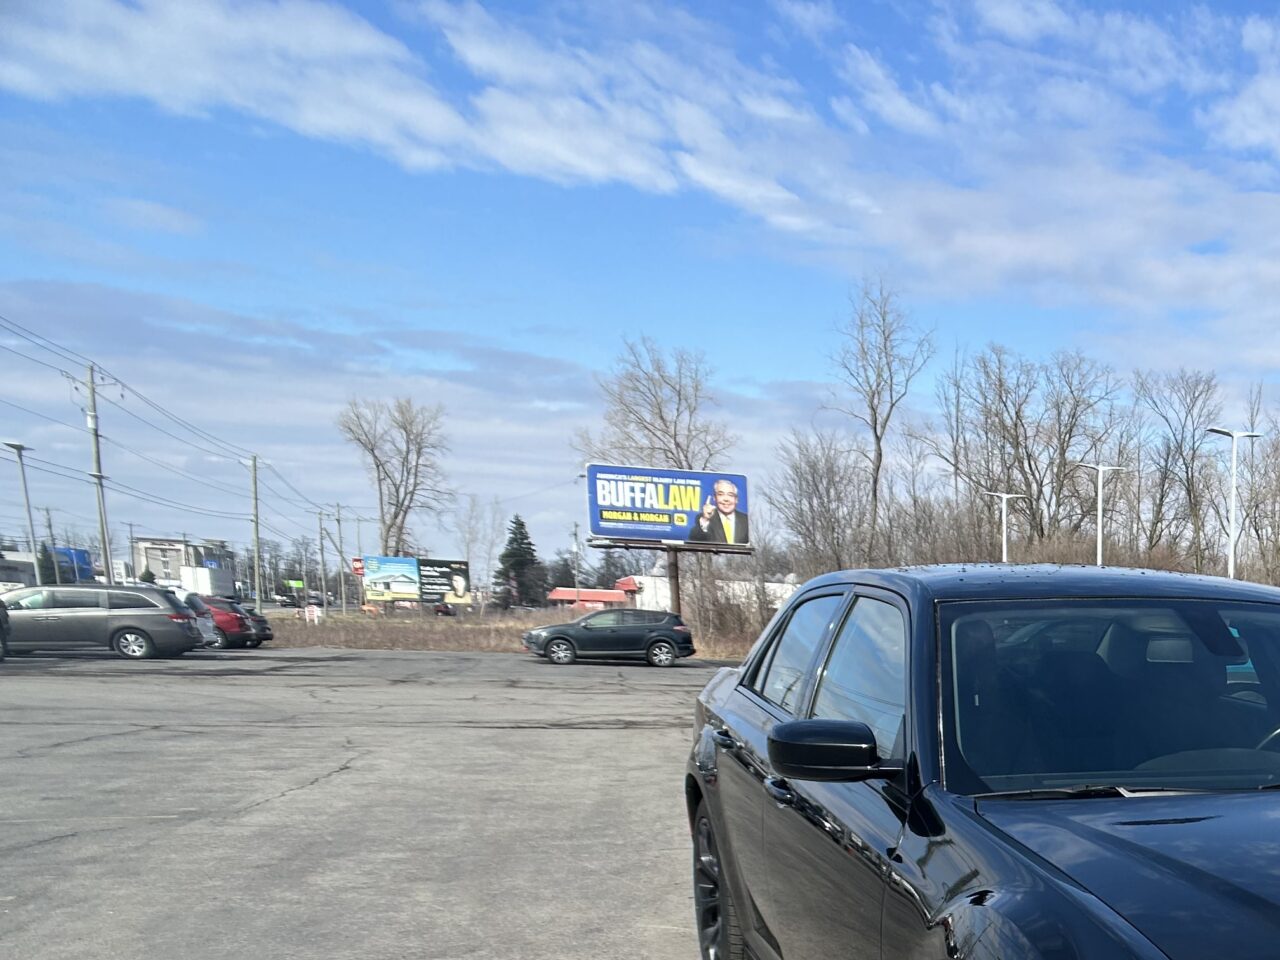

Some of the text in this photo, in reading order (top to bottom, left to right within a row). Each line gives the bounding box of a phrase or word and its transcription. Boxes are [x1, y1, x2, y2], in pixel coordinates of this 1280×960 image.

[596, 479, 701, 512] BUFFALAW
[602, 510, 632, 521] MORGAN
[640, 513, 669, 522] MORGAN
